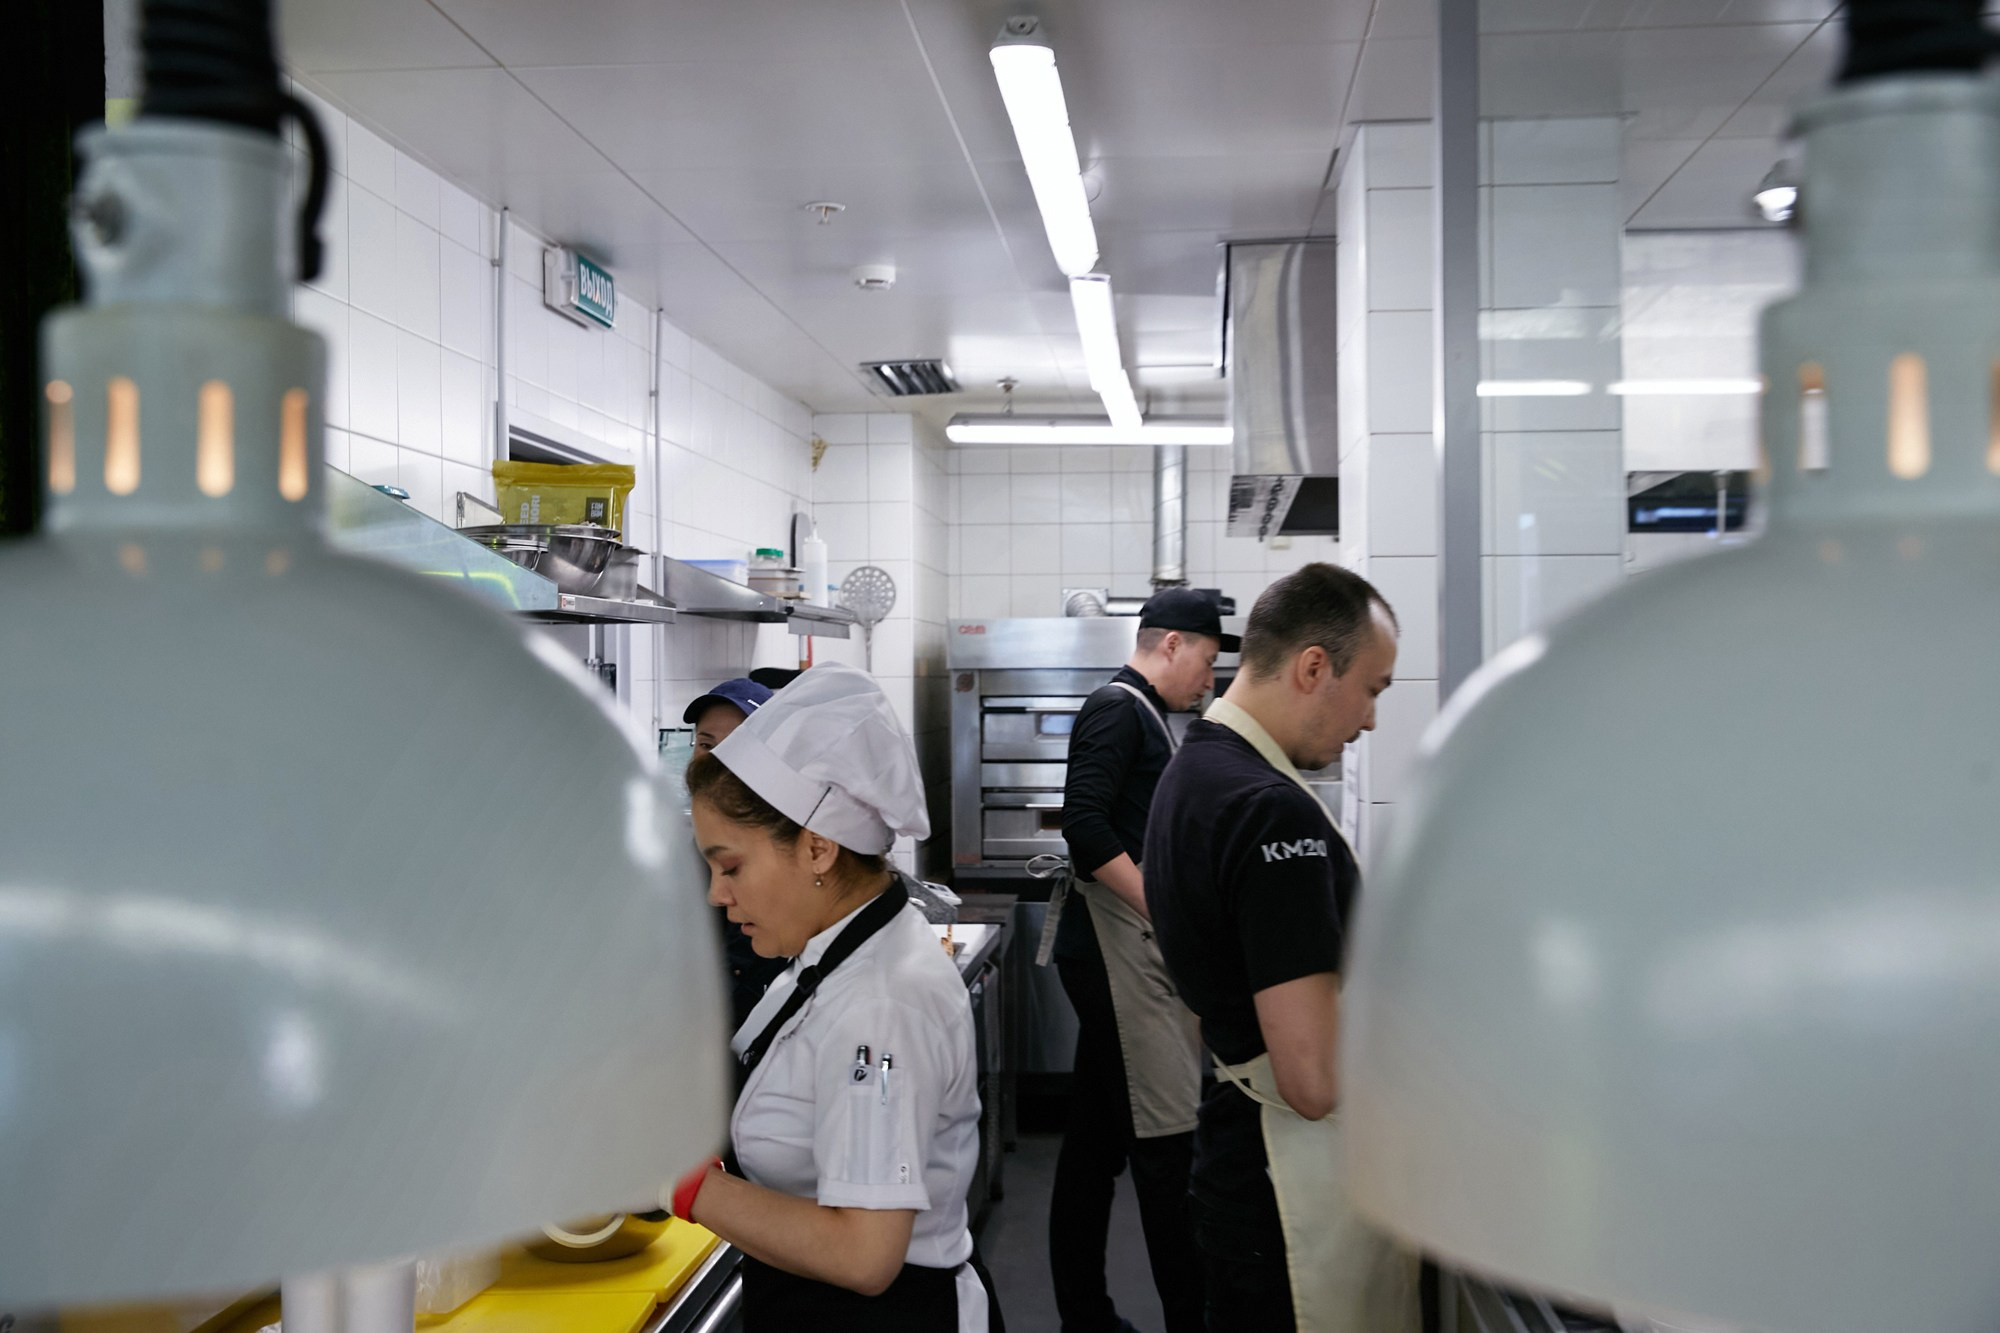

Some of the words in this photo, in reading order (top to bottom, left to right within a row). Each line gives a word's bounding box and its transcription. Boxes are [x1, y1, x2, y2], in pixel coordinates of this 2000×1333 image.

[580, 263, 613, 319] ВЫХОД
[530, 494, 541, 525] NORI
[1261, 838, 1327, 862] KM20
